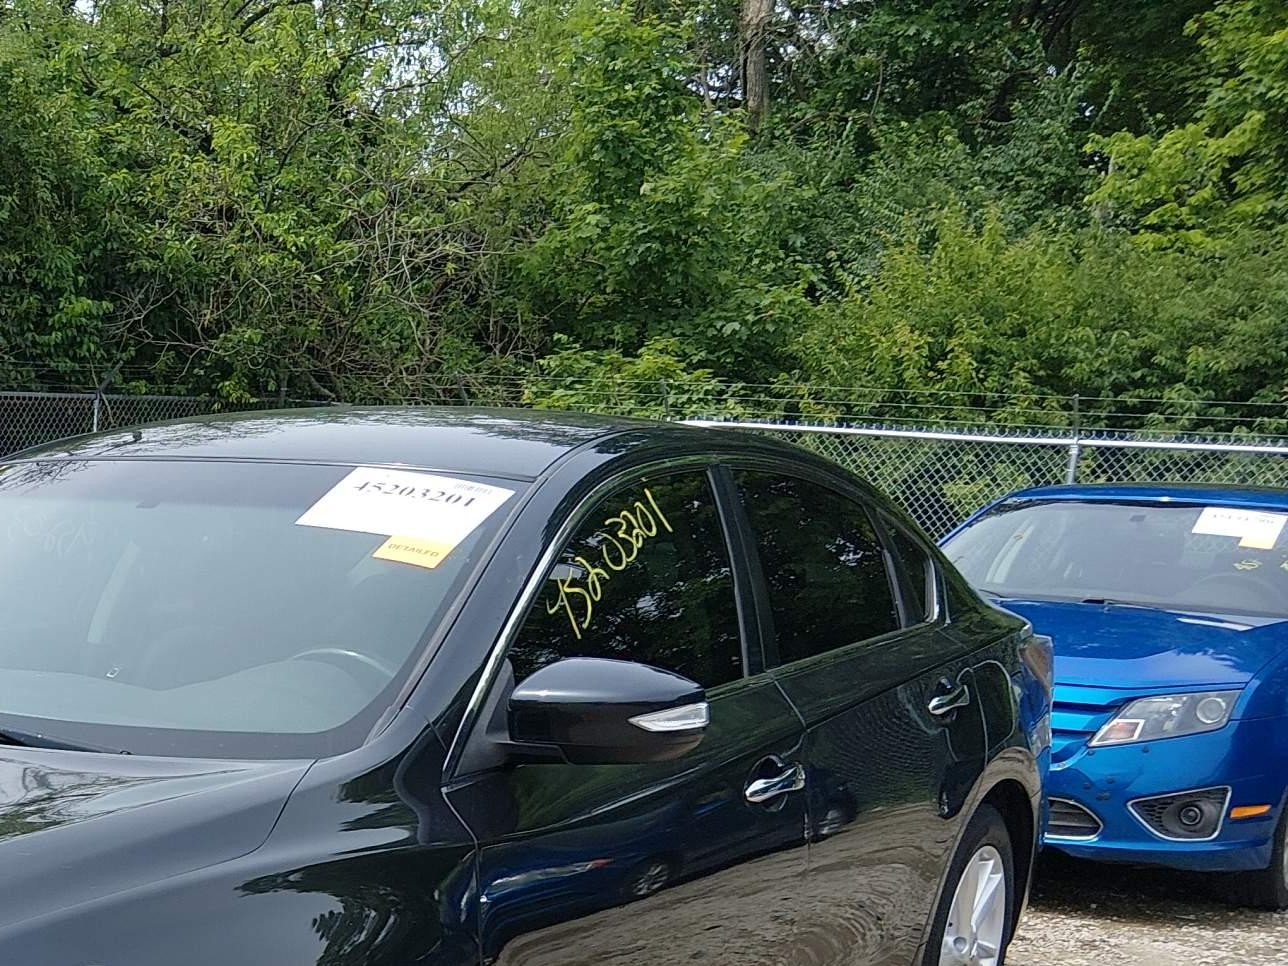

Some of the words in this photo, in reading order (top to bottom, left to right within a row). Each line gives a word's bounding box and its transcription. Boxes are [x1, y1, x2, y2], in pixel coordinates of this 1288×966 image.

[353, 480, 476, 507] 45203201
[387, 543, 440, 557] DETAILED
[547, 488, 673, 639] 45203201
